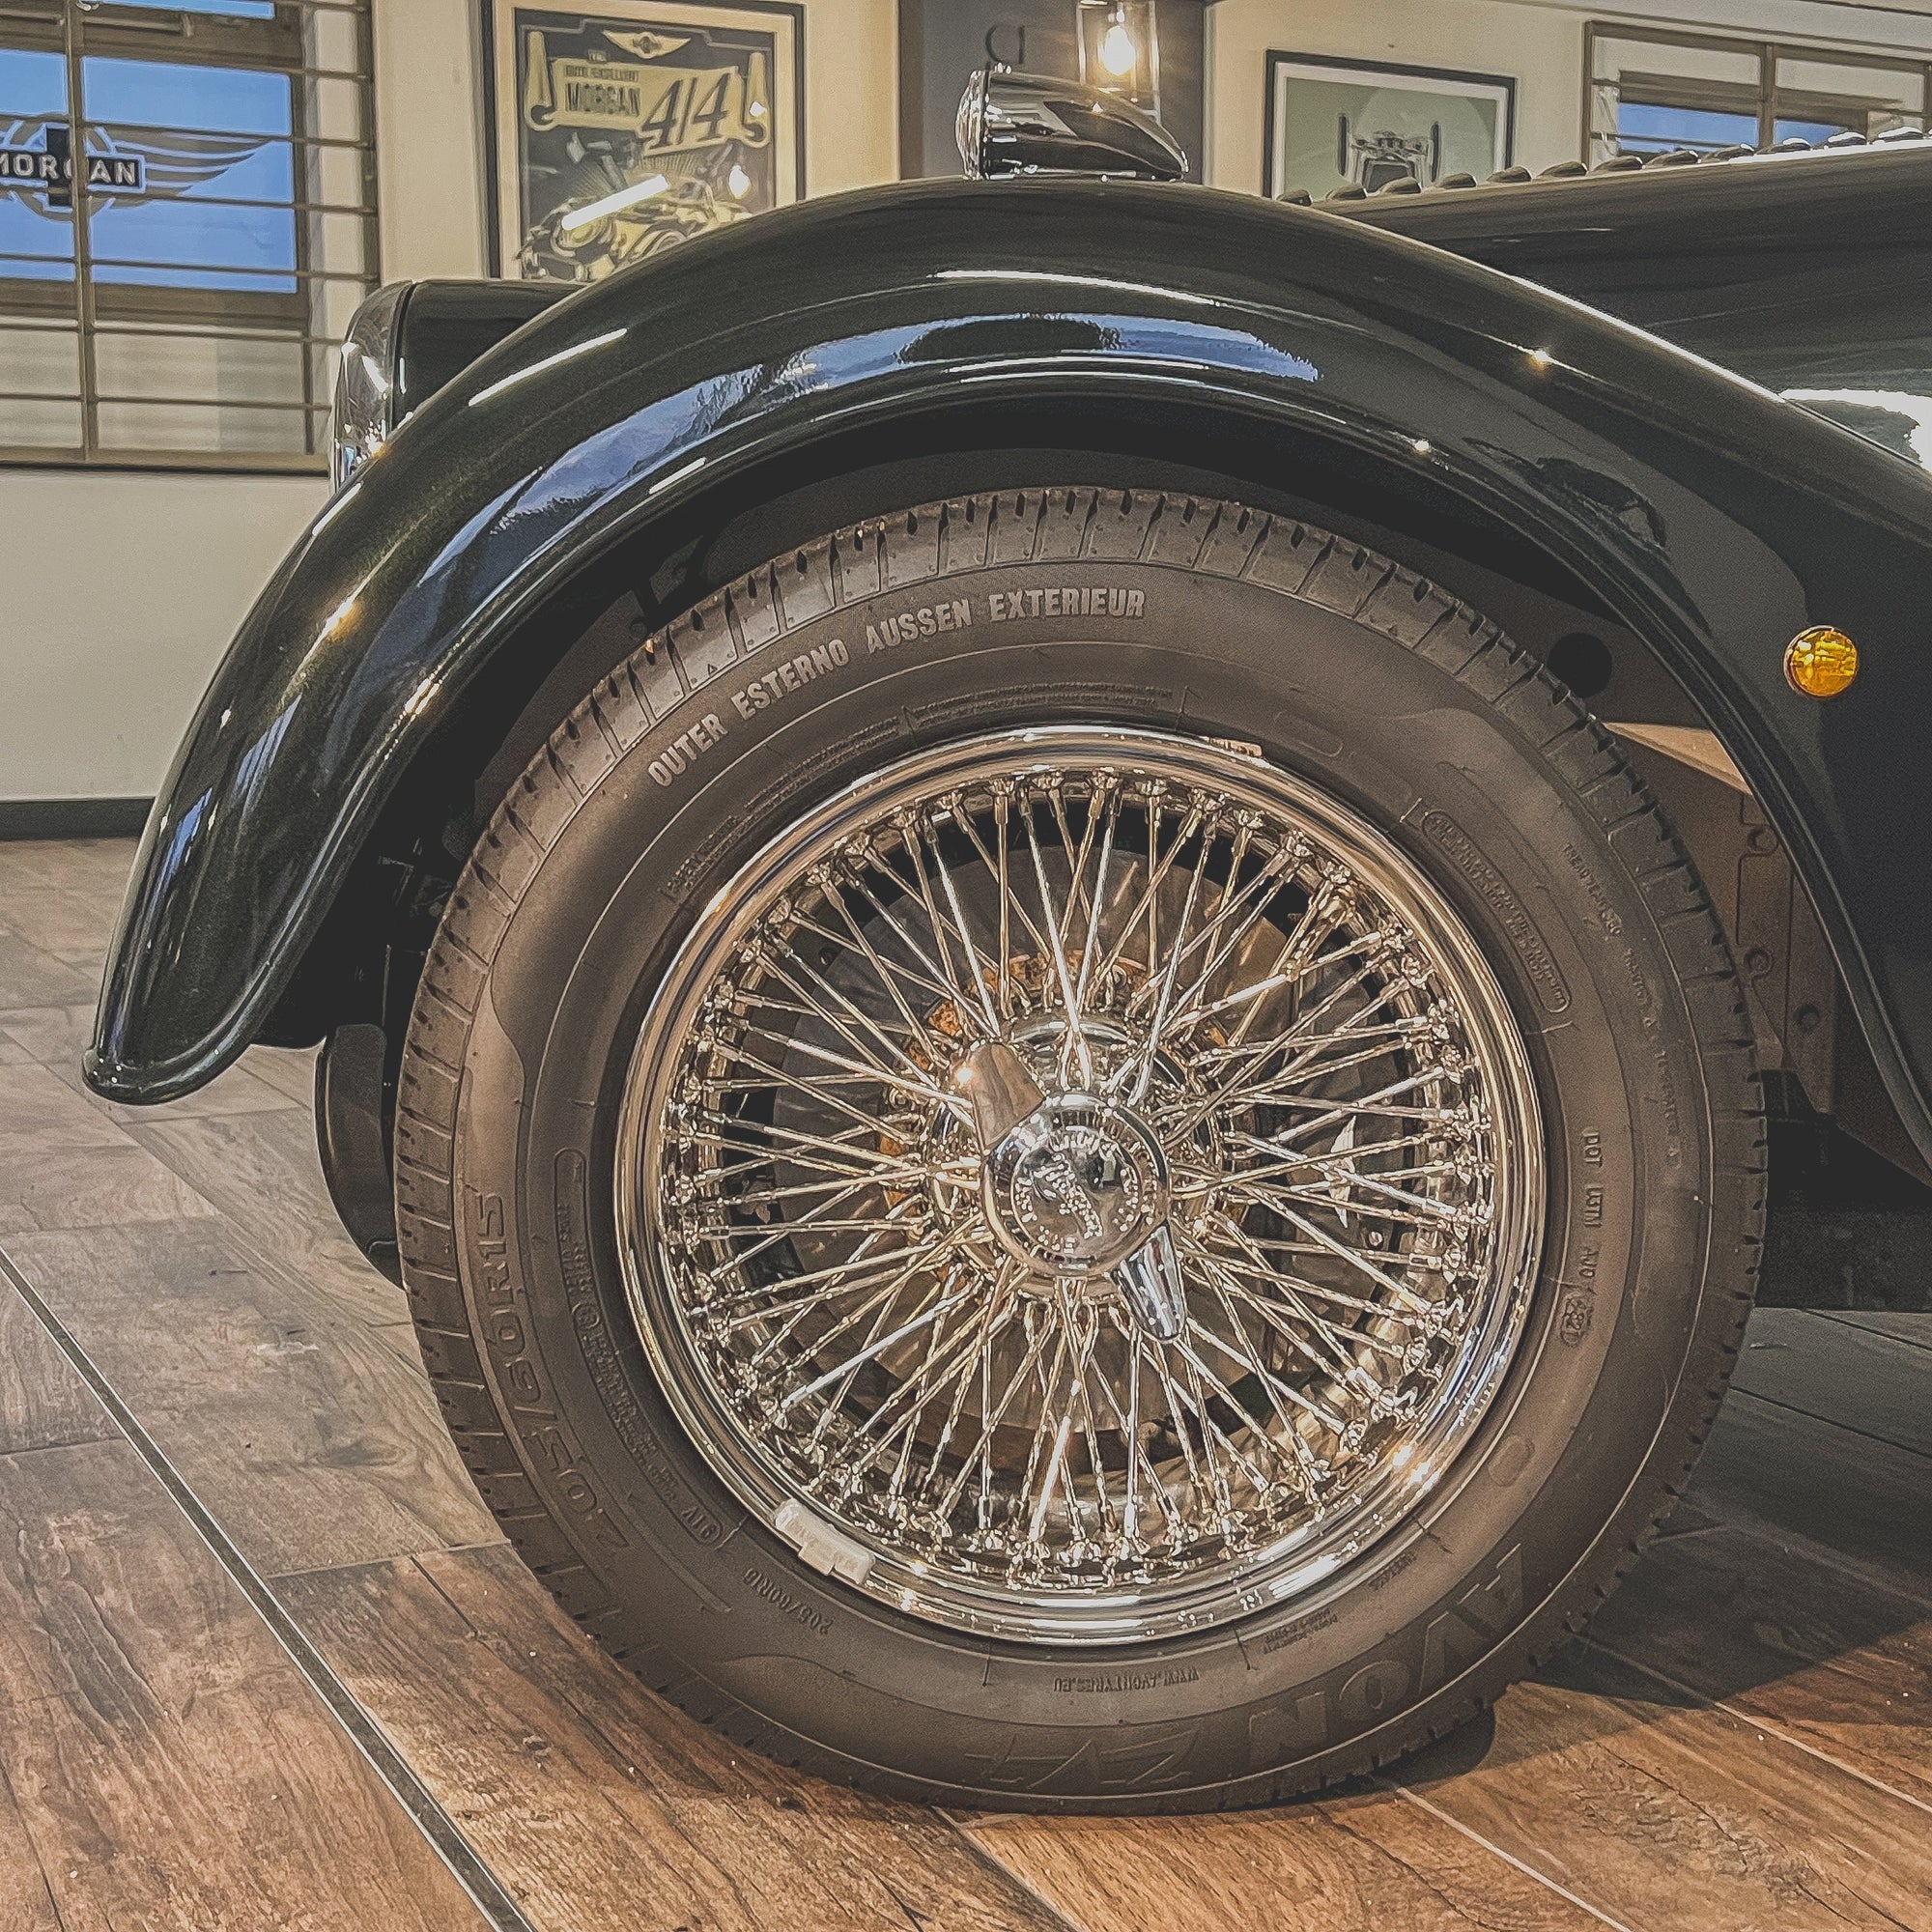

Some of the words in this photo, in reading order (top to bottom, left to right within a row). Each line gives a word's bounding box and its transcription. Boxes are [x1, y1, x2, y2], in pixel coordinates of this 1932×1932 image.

[641, 68, 729, 146] 4/4
[647, 712, 729, 788] OUTER
[730, 638, 850, 720] ESTERNO
[865, 598, 972, 654] AUSSEN
[988, 587, 1146, 623] EXTERIEUR
